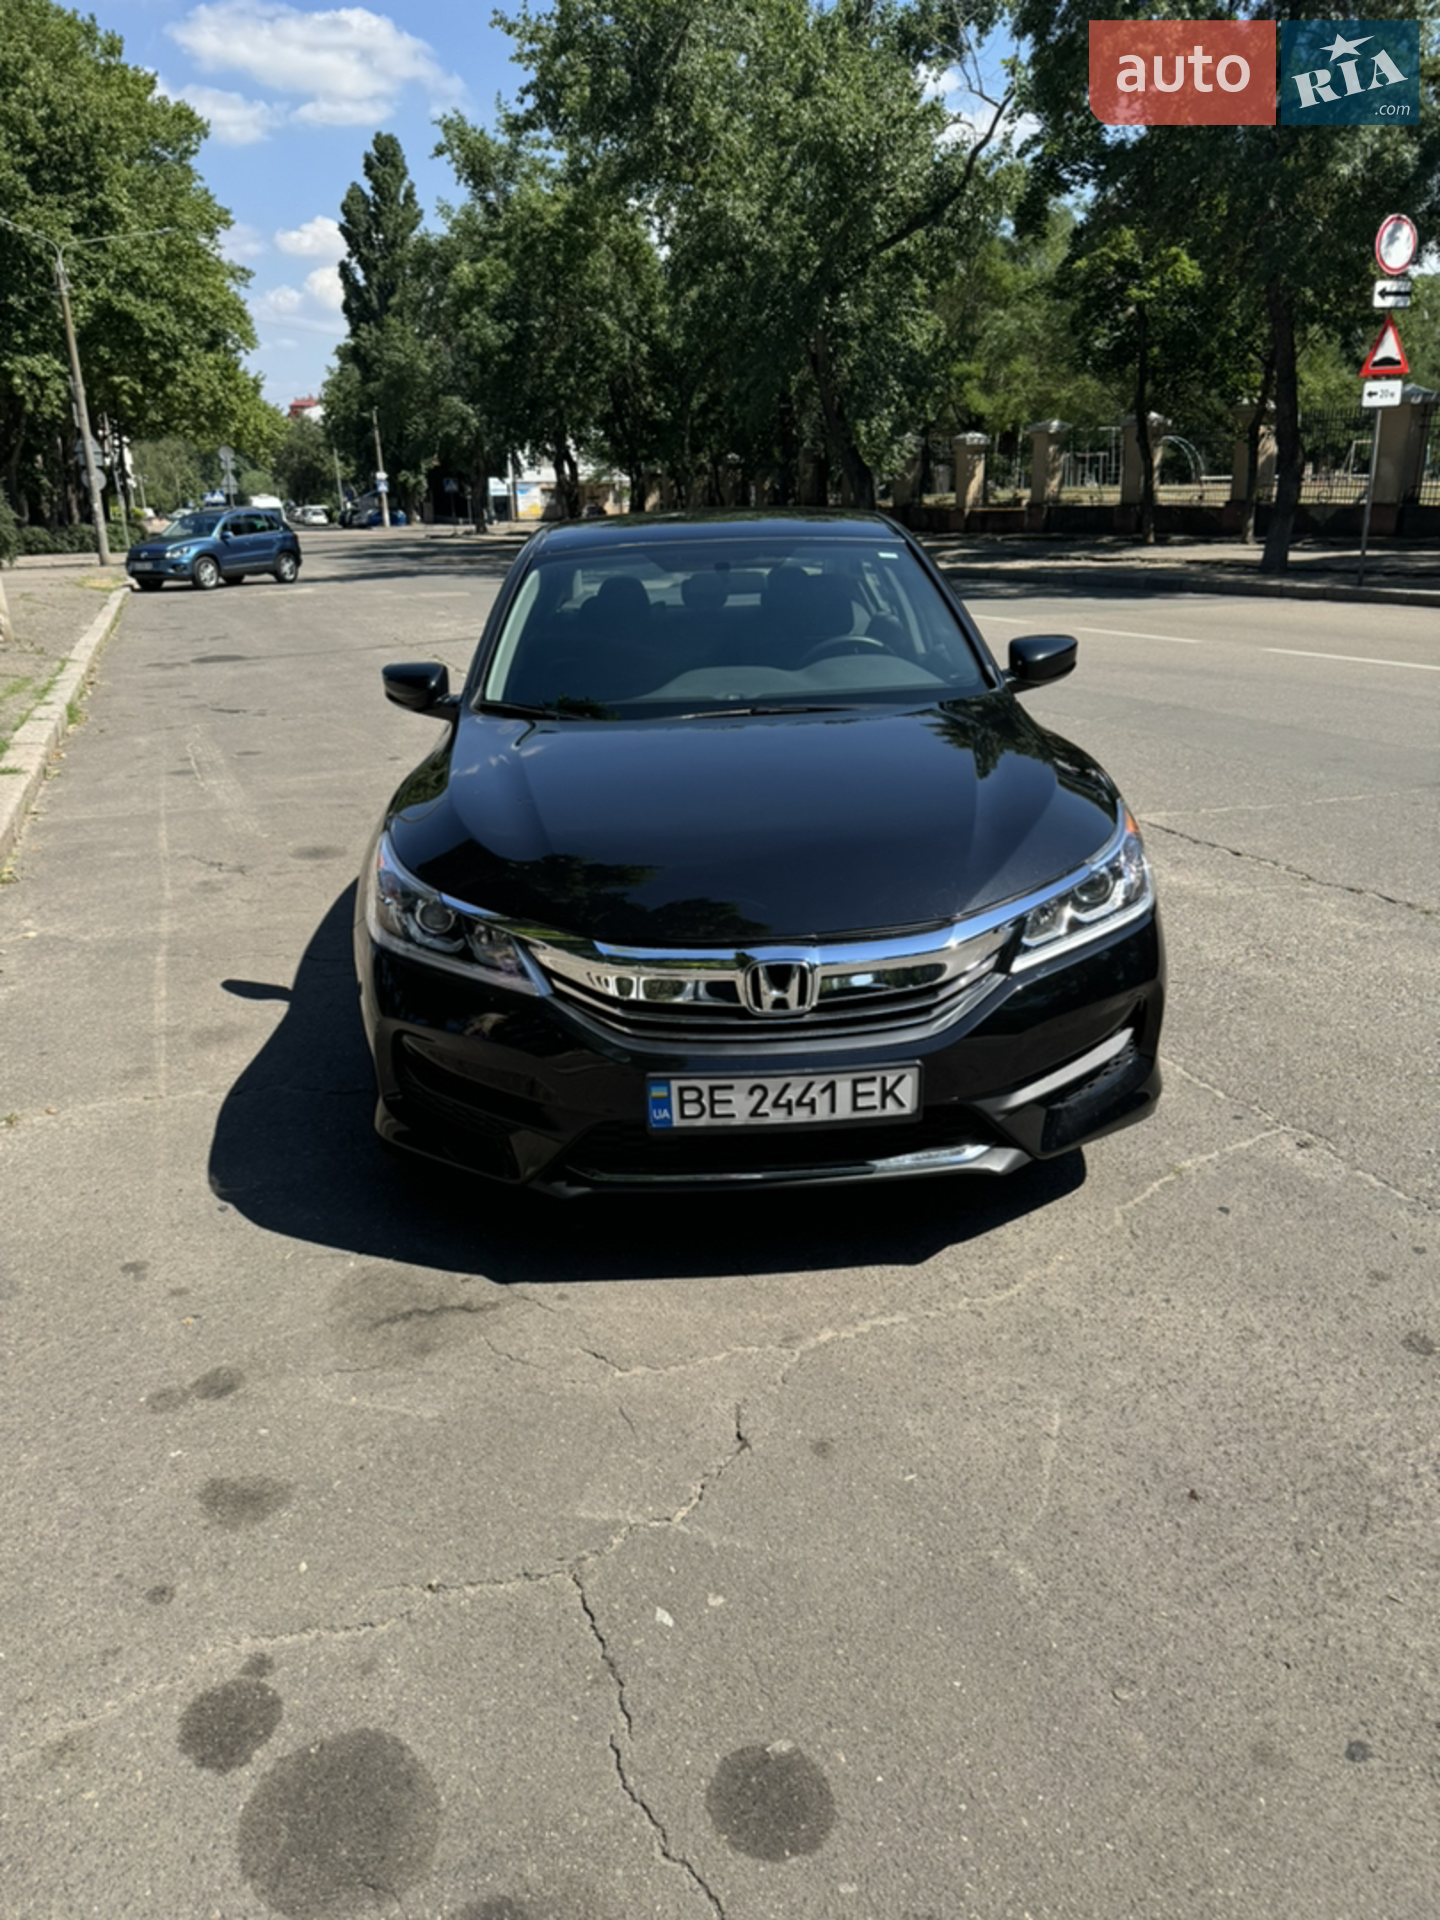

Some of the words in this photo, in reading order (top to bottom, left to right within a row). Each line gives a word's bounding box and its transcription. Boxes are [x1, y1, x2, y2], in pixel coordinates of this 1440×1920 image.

[677, 1085, 736, 1120] BE
[748, 1080, 837, 1118] 2441
[851, 1074, 907, 1112] EK
[652, 1109, 670, 1120] UA
